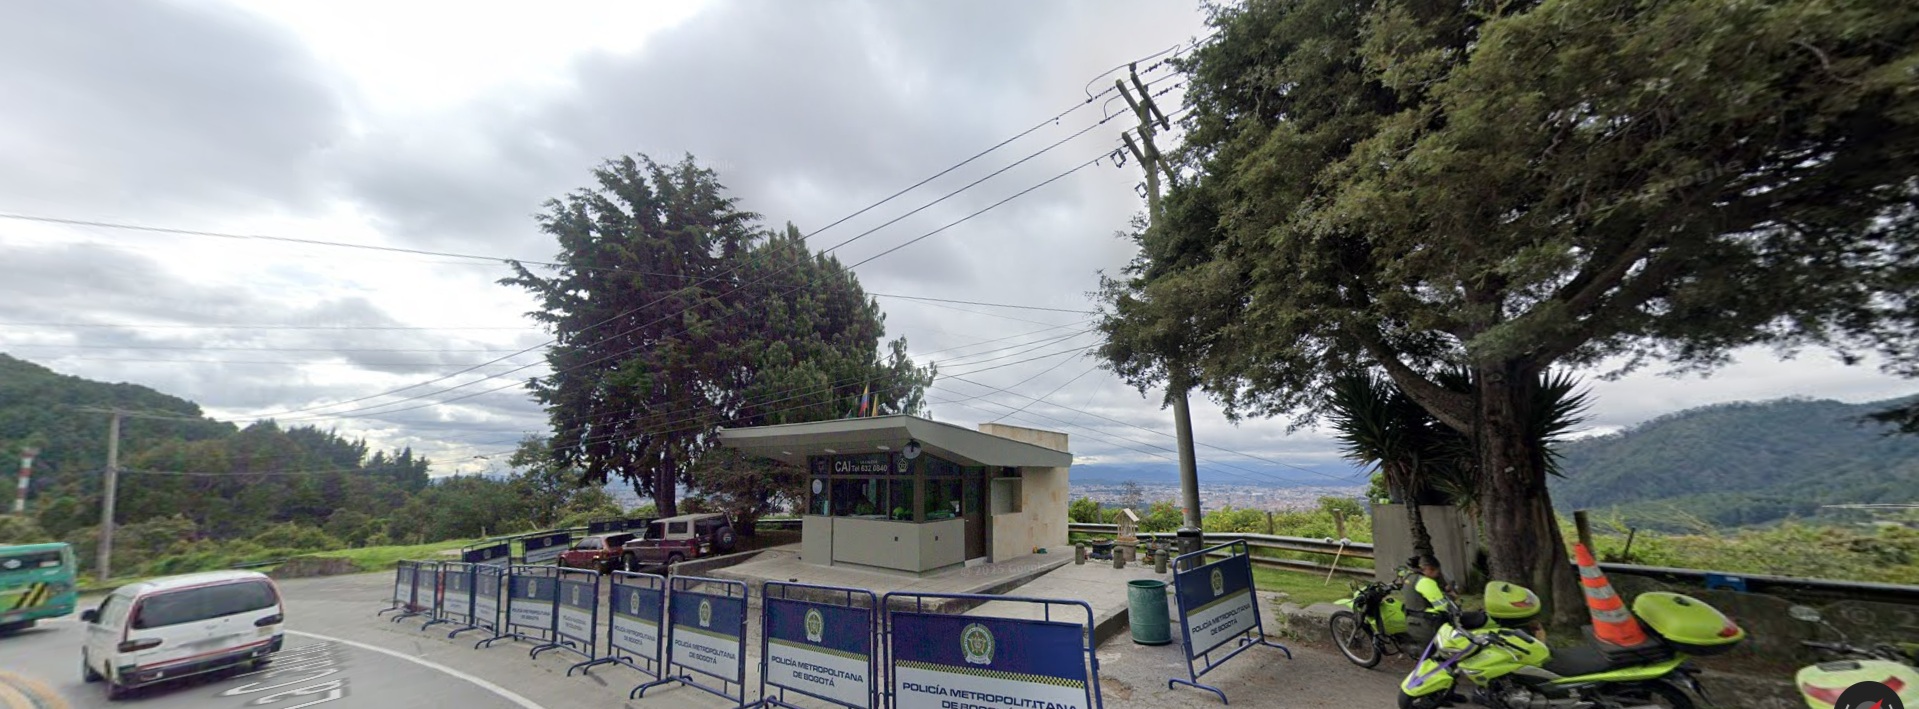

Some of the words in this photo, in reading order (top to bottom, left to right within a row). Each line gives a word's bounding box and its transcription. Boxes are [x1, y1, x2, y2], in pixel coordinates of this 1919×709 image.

[835, 461, 851, 472] CAI
[1212, 603, 1251, 624] METROPOLITANA
[692, 643, 736, 660] METROPOLITANA
[696, 653, 717, 664] BOGOTÁ
[771, 655, 797, 668] POLICÍA
[797, 662, 864, 683] METROPOLITANA
[792, 670, 803, 679] DE
[803, 673, 835, 687] BOGOTÁ
[902, 682, 948, 696] POLICÍA
[941, 700, 958, 709] DE
